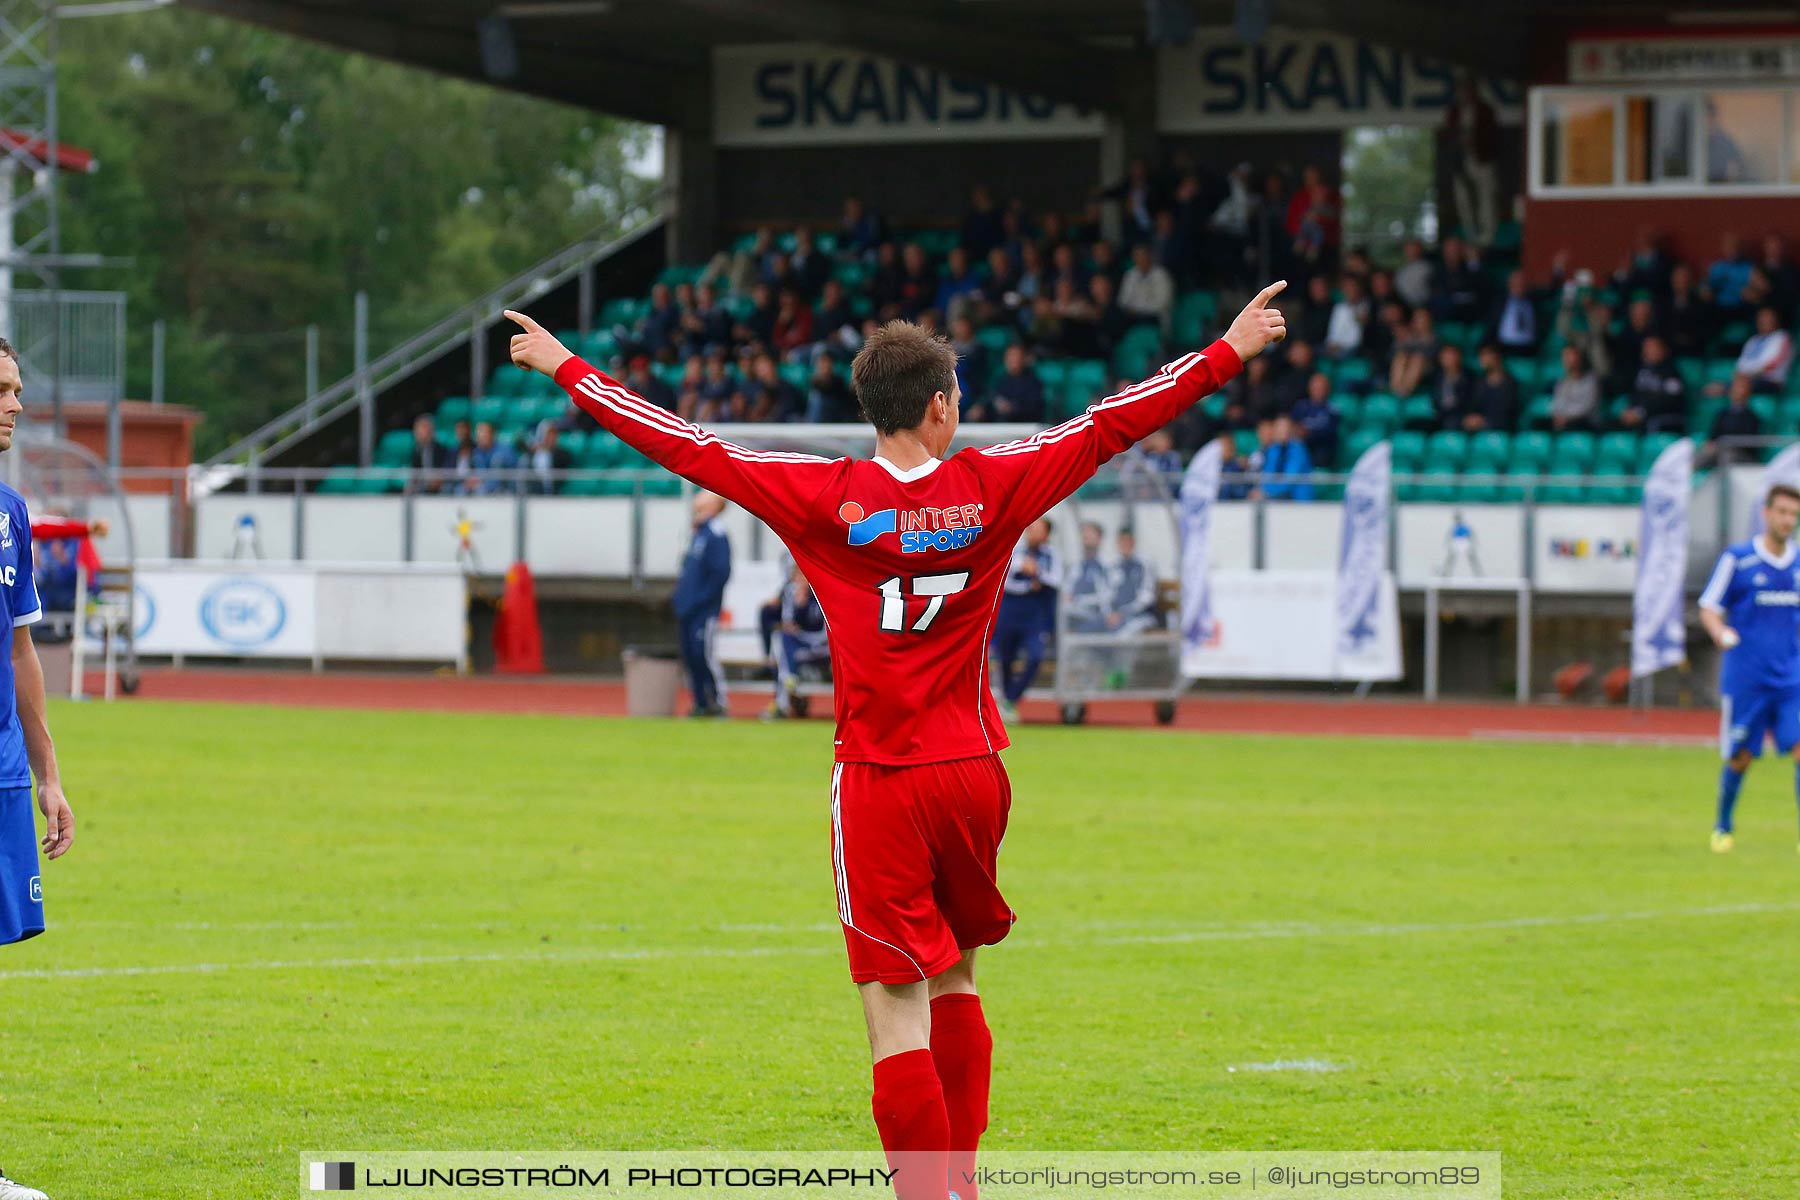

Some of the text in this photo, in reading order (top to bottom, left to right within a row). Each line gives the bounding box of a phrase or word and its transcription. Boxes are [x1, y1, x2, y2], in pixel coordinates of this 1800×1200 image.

[900, 504, 983, 531] INTER
[900, 526, 982, 553] SPORT
[876, 570, 971, 634] 17
